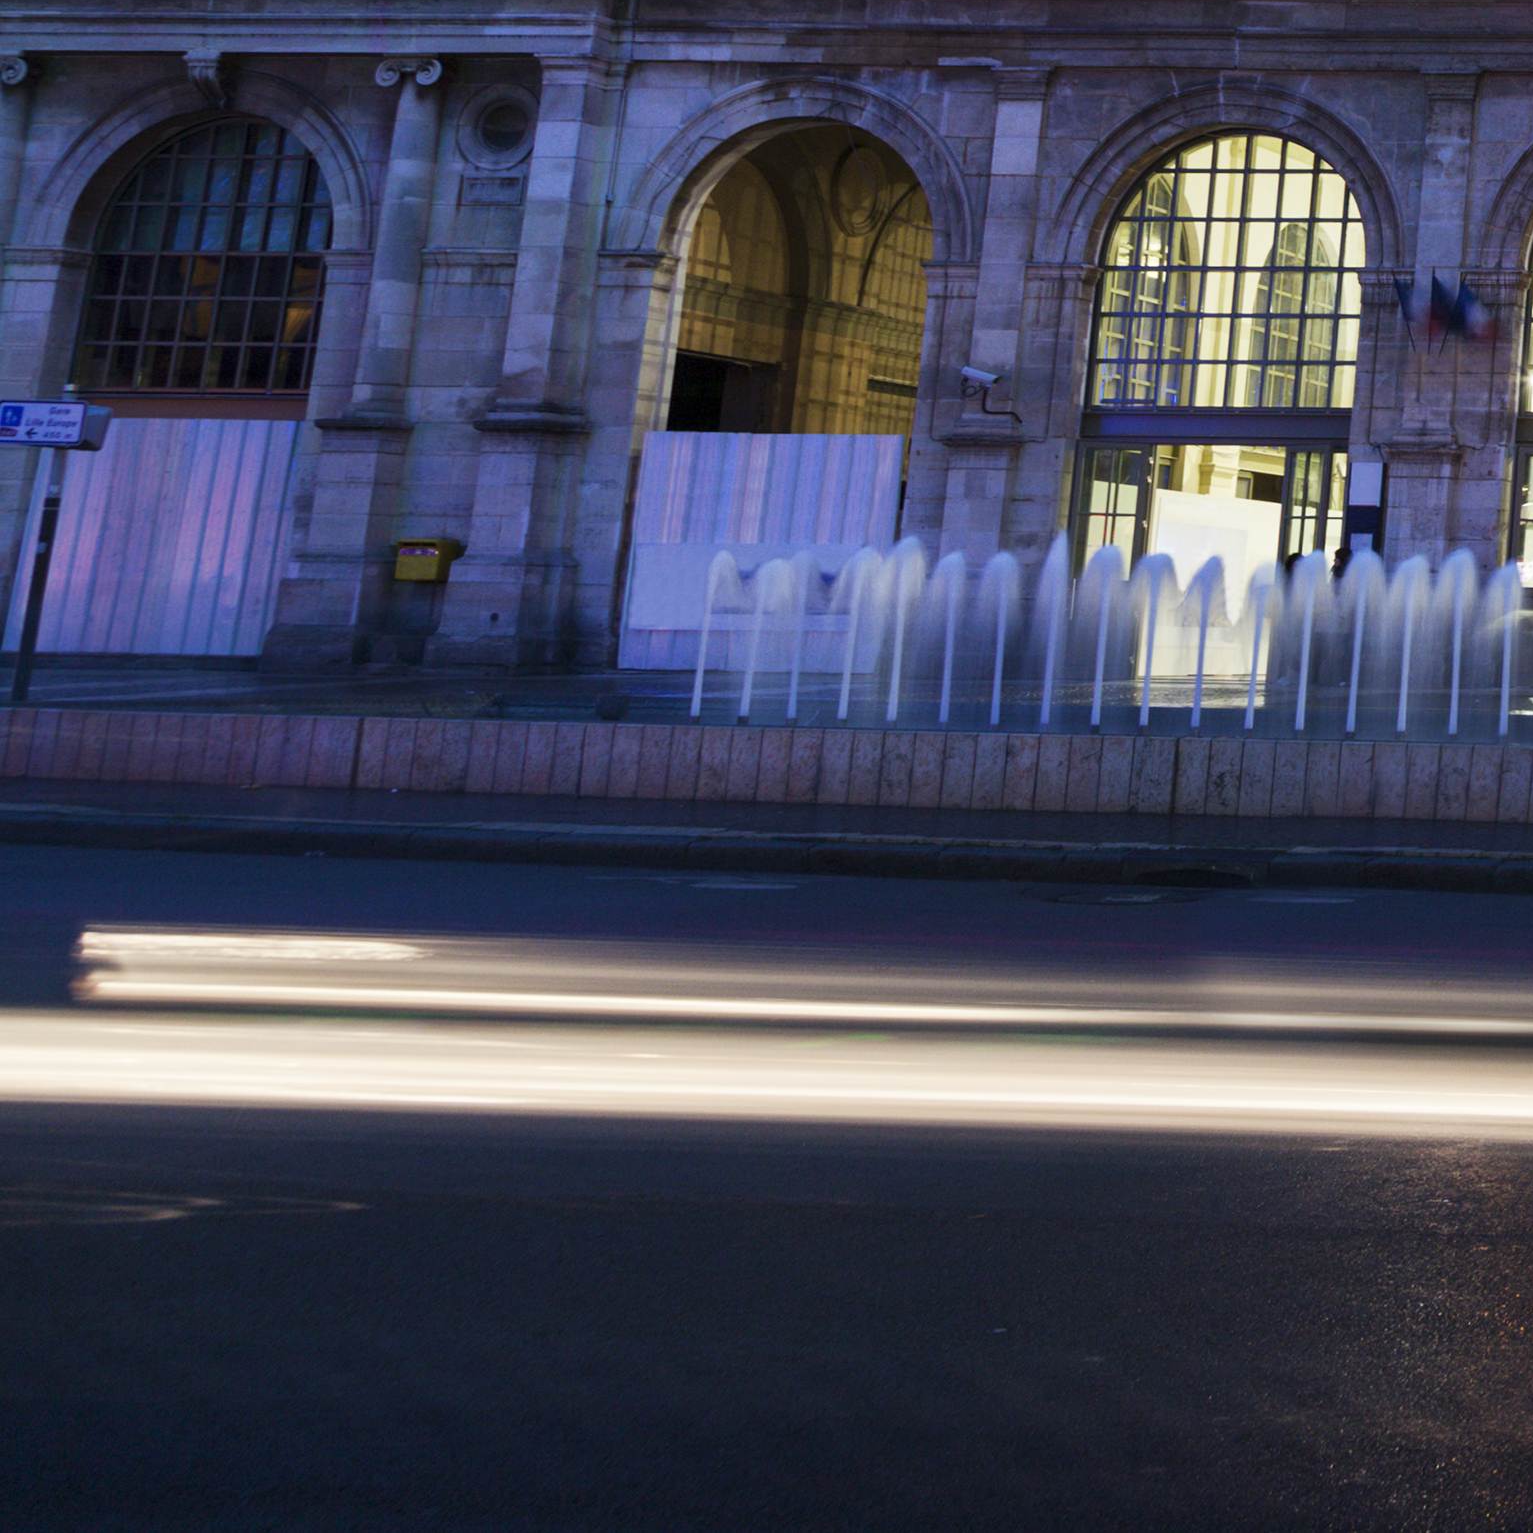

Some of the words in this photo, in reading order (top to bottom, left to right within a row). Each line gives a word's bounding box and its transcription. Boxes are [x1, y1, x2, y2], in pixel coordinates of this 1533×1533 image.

[49, 406, 71, 415] Gare
[25, 418, 45, 426] Lille
[47, 418, 78, 429] Europe
